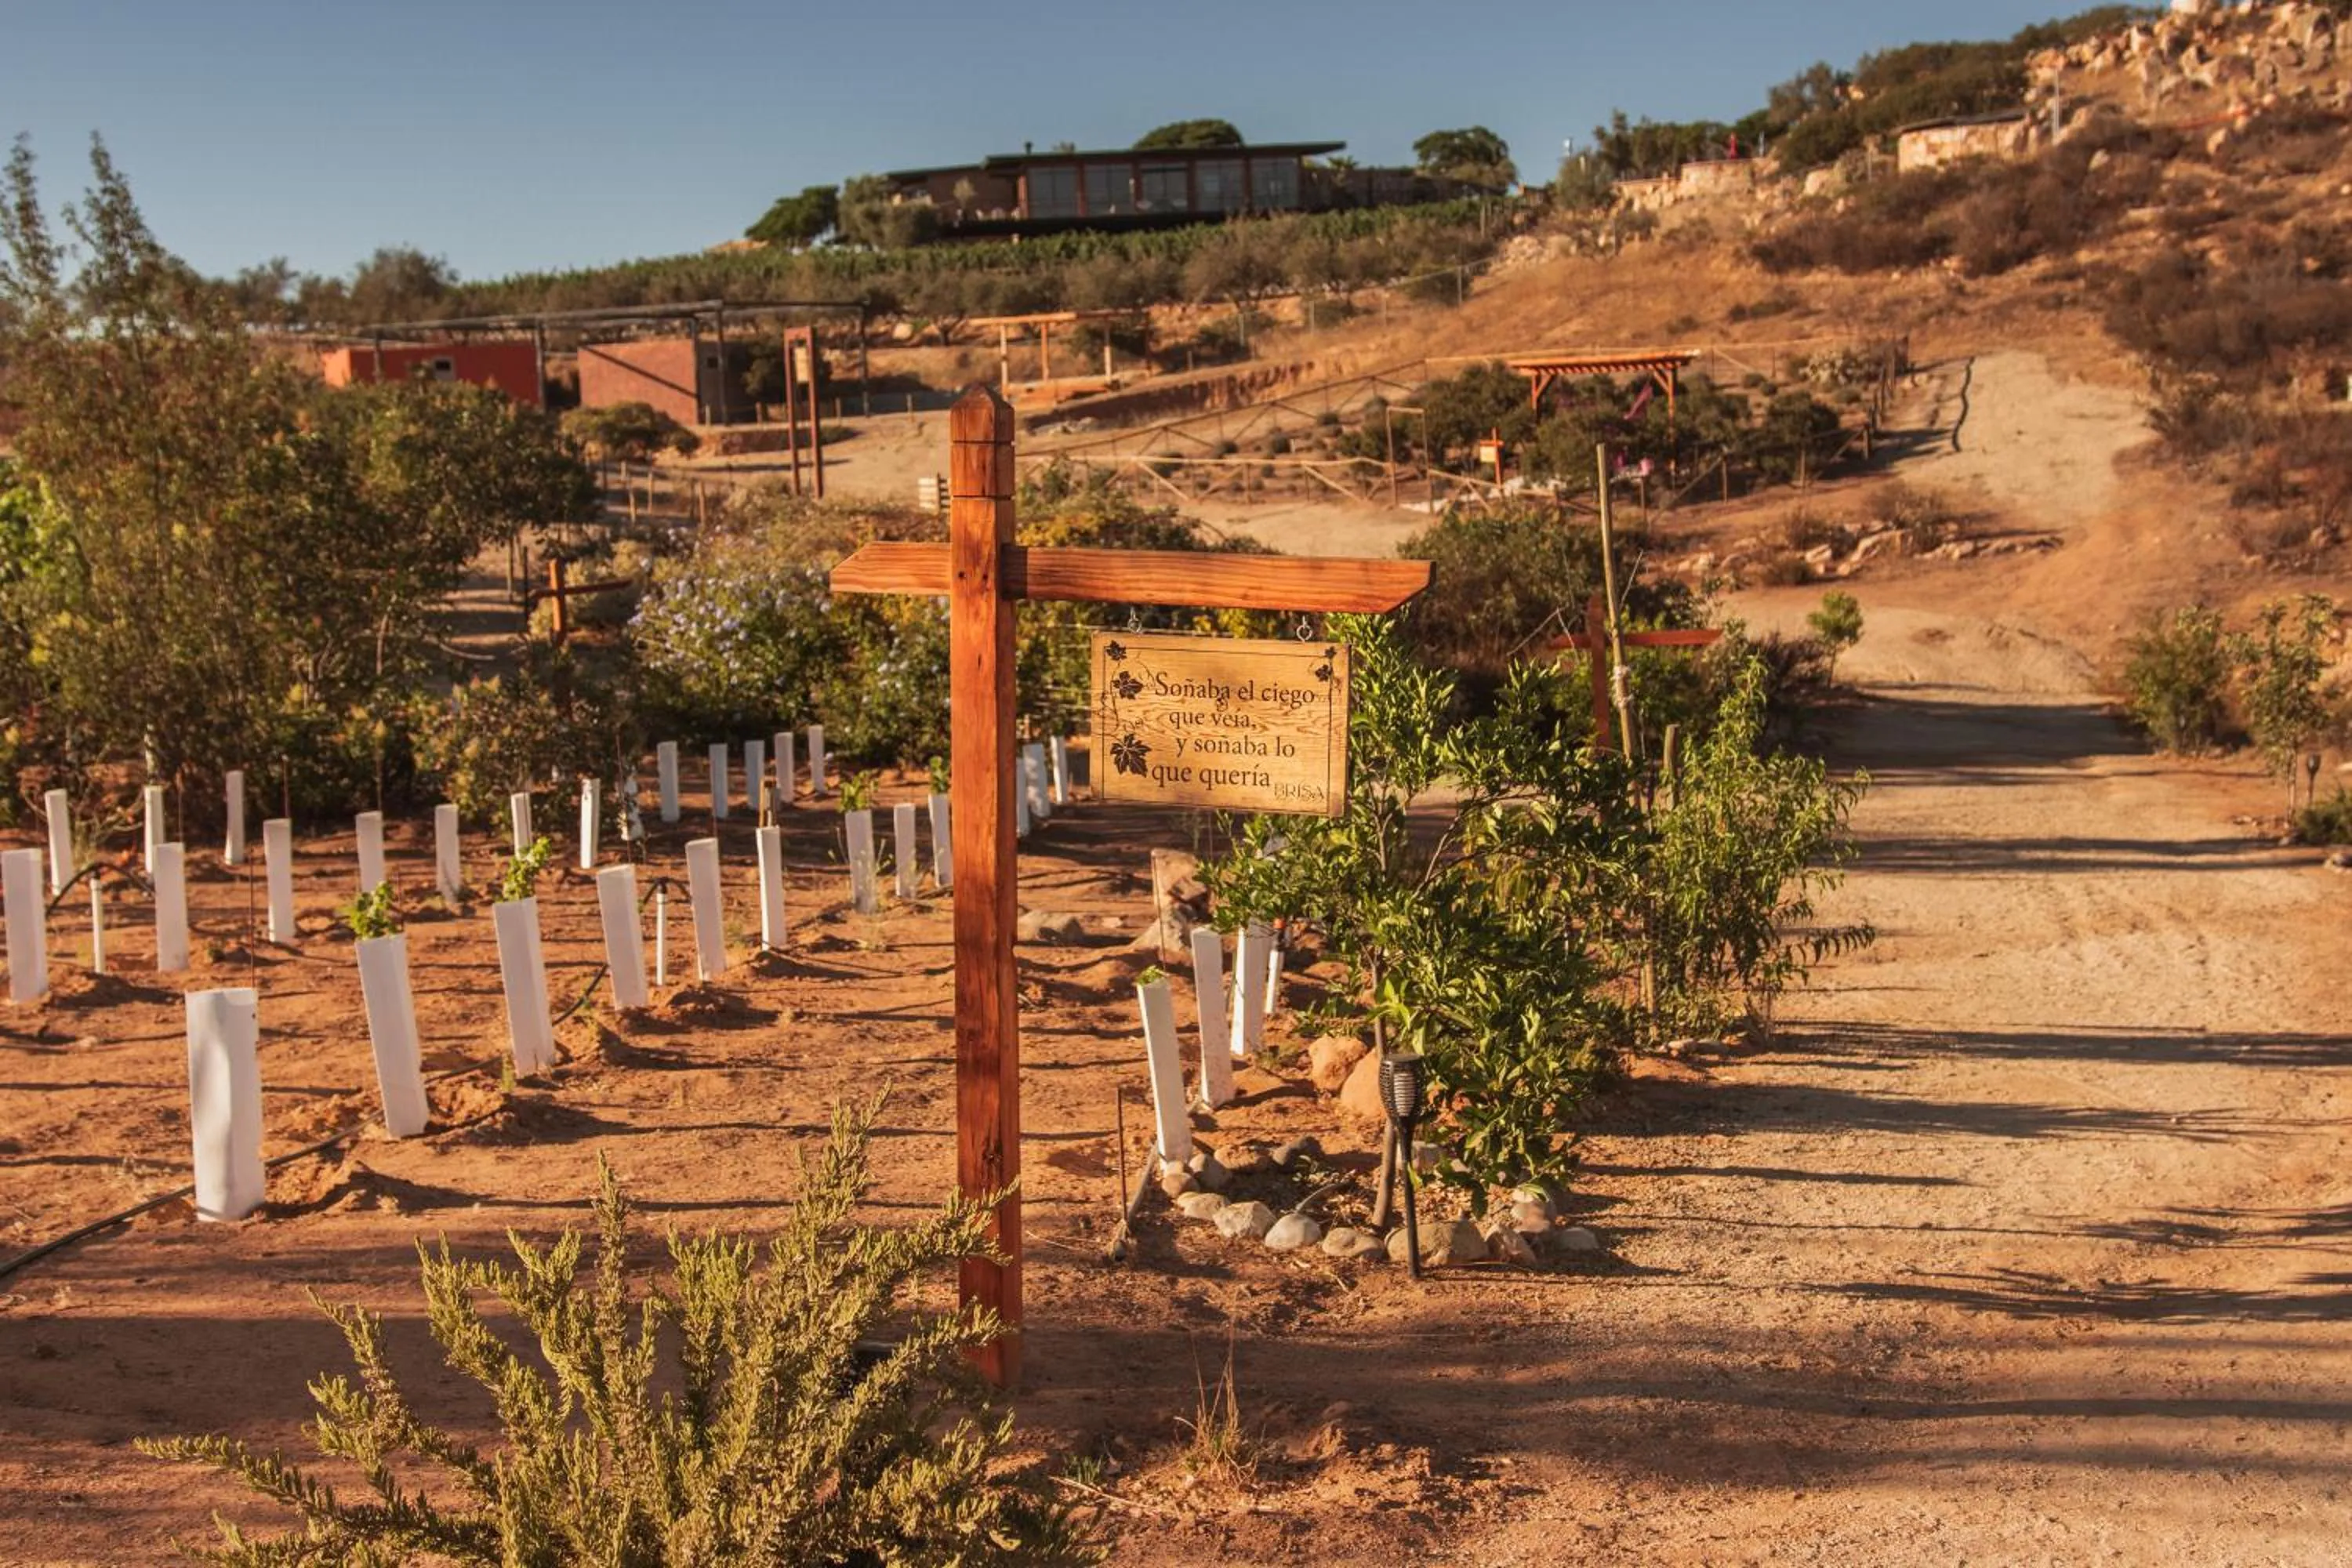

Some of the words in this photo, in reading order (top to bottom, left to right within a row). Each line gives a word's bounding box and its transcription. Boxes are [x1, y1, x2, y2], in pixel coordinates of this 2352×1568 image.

[1155, 671, 1230, 699] Soñaba
[1237, 680, 1254, 701] el
[1261, 681, 1316, 710] ciego
[1169, 710, 1205, 730] que
[1210, 707, 1258, 729] veía,
[1176, 737, 1188, 758] y
[1193, 734, 1268, 757] soñaba
[1275, 735, 1295, 758] lo
[1151, 764, 1192, 788] que
[1199, 764, 1270, 791] quería
